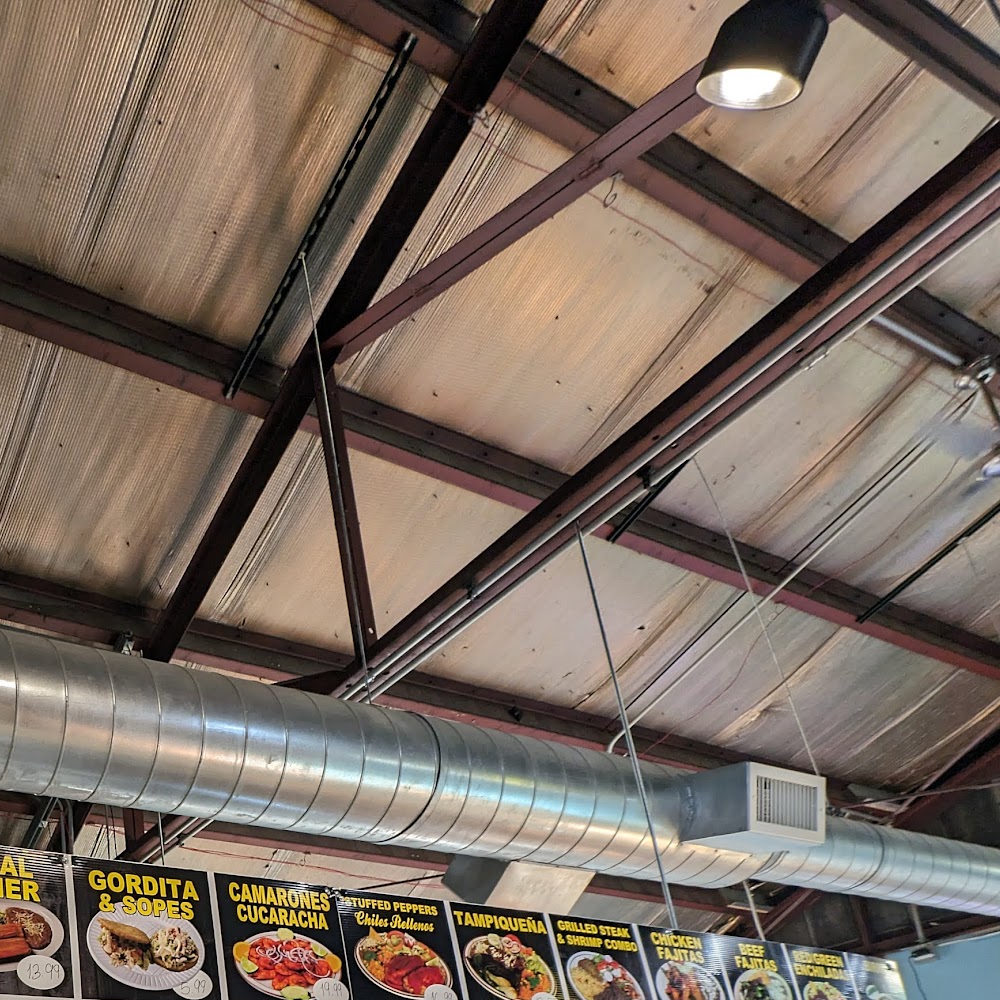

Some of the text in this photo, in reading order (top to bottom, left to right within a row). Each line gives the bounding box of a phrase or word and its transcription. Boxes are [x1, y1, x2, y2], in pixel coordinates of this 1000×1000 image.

[88, 869, 199, 901] GORDITA
[228, 882, 331, 912] CAMARONES
[99, 893, 195, 921] & SOPES
[393, 902, 438, 916] PEPPERS
[236, 904, 329, 930] CUCARACHA
[354, 911, 434, 932] Chiles Rellenos
[453, 910, 547, 935] TAMPIQUEÑA
[557, 920, 631, 938] GRILLED STEAK
[556, 934, 638, 952] & SHRIMP COMBO
[650, 932, 702, 950] CHICKEN
[738, 943, 765, 957] BEEF
[656, 946, 704, 964] FAJITAS
[734, 956, 778, 972] FAJITAS
[27, 963, 61, 981] 13.99
[180, 978, 207, 995] 5.99
[320, 981, 342, 997] 19.99
